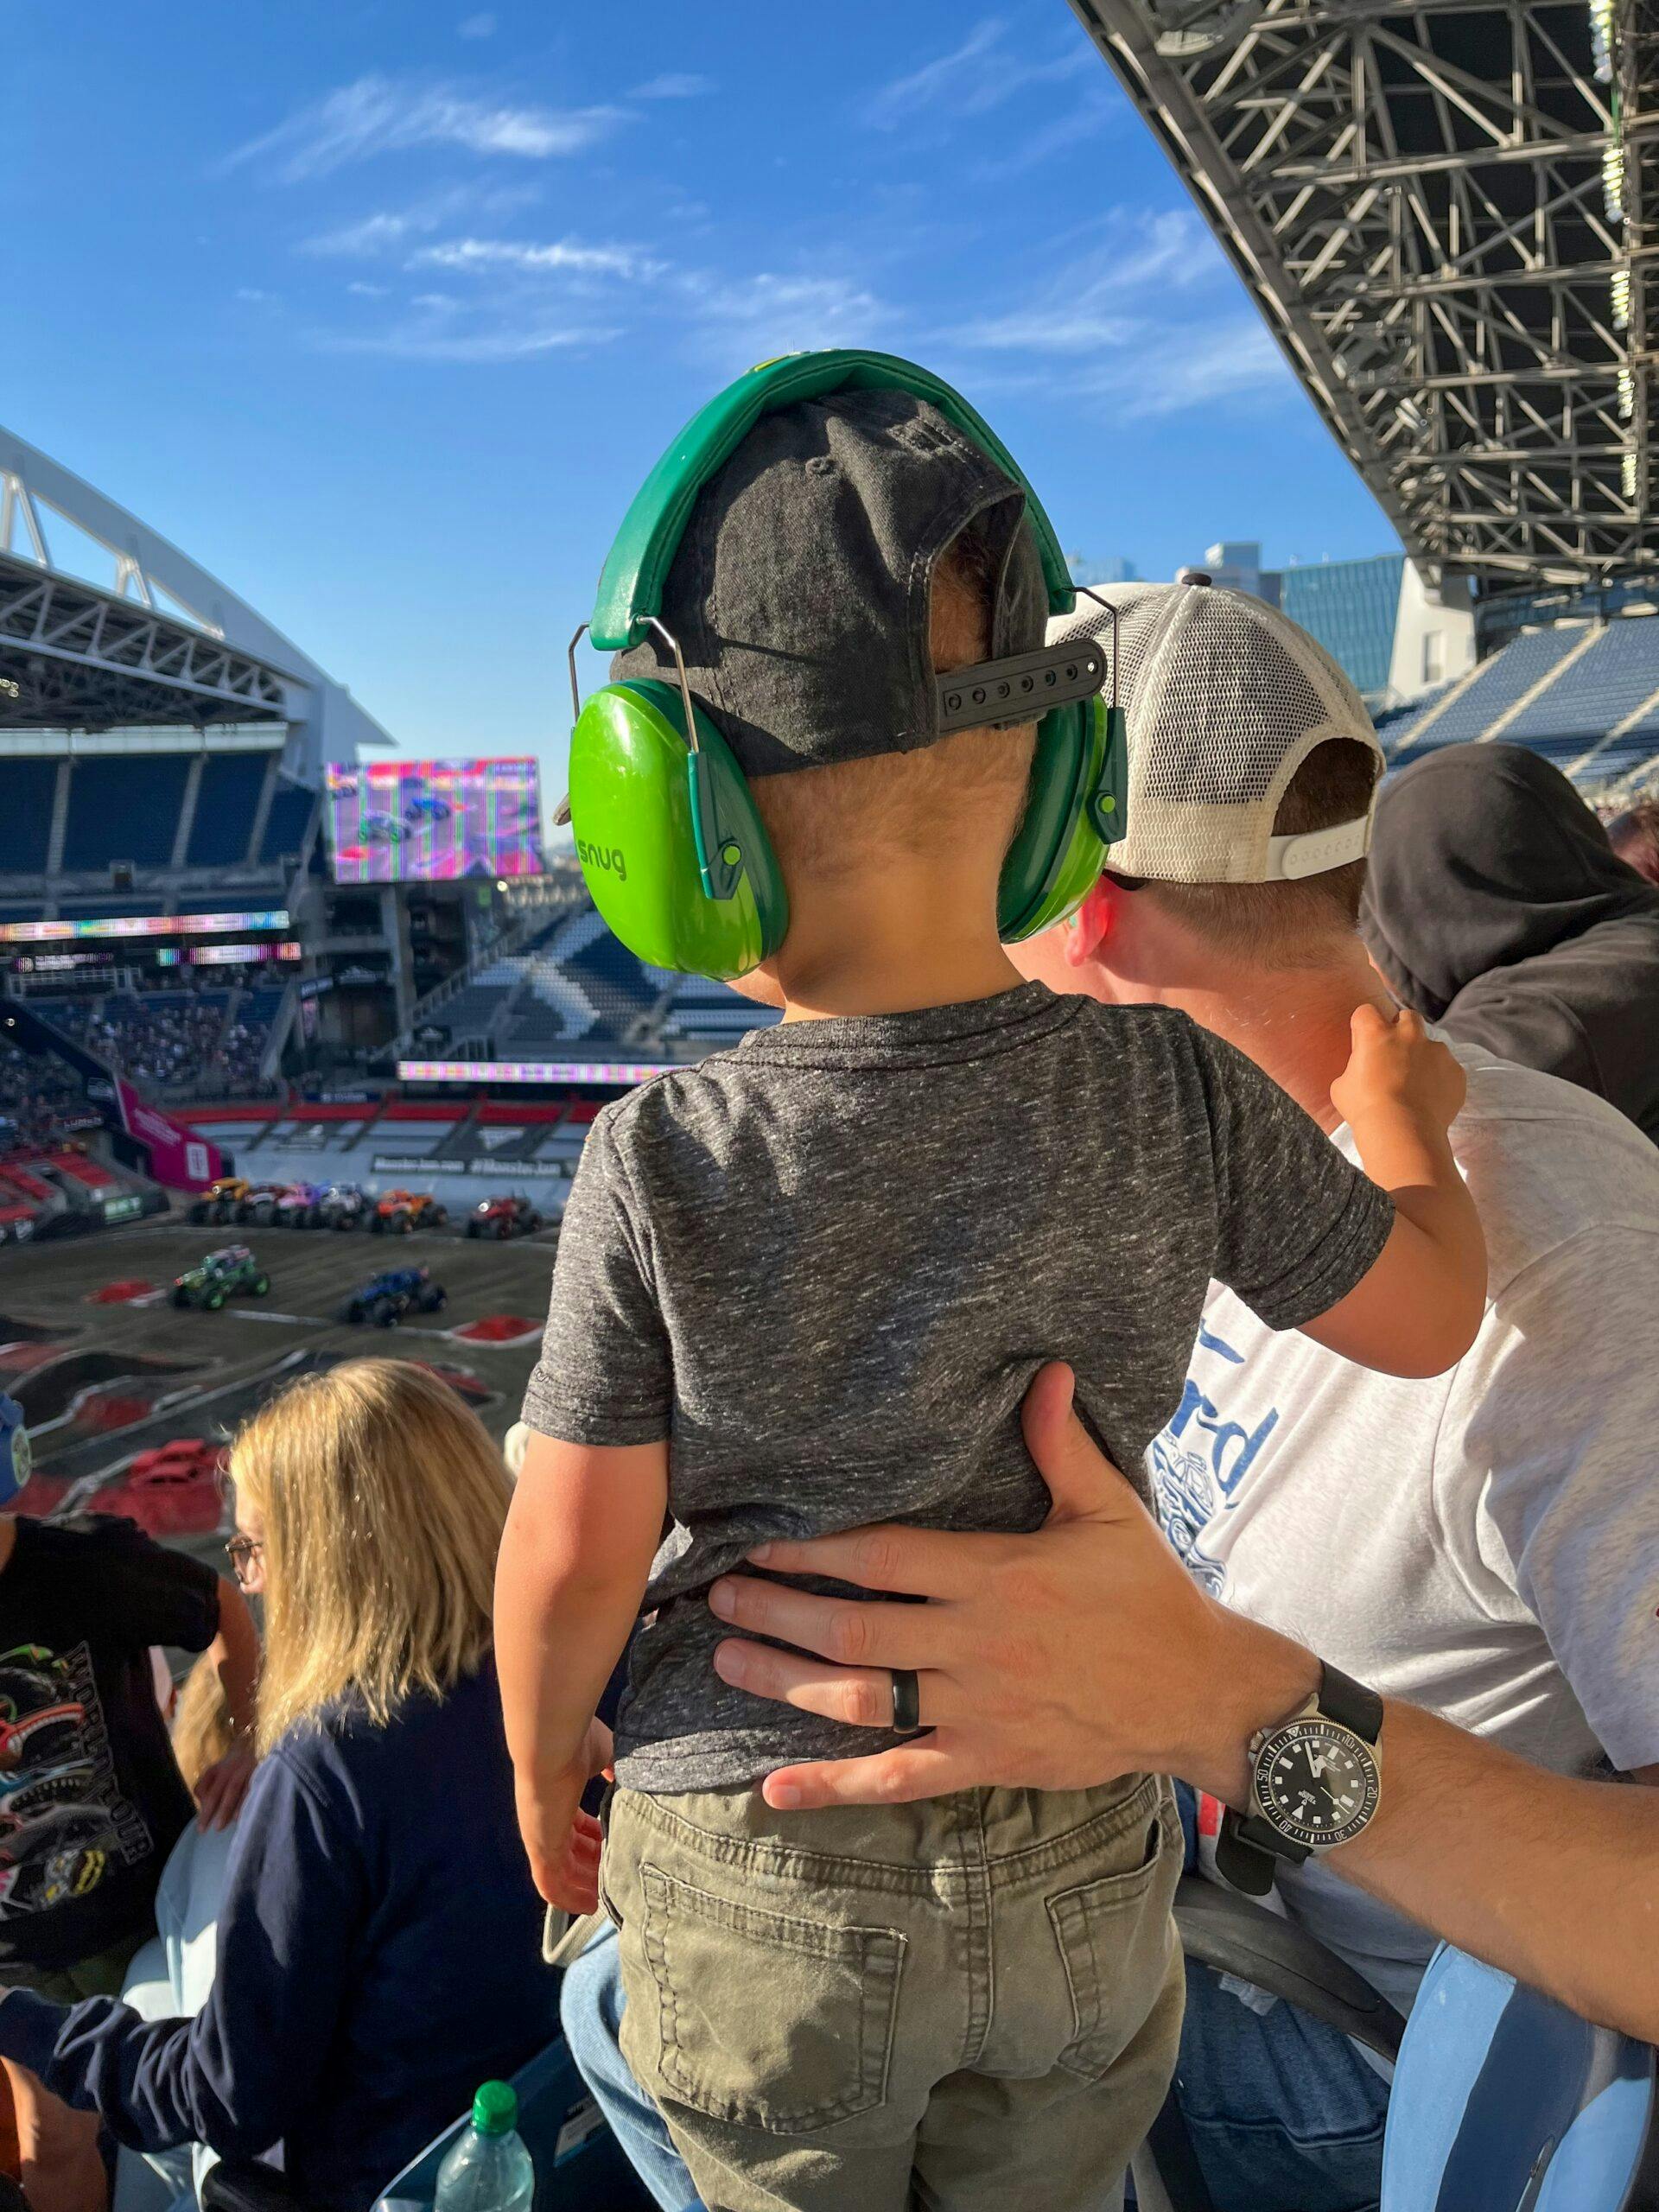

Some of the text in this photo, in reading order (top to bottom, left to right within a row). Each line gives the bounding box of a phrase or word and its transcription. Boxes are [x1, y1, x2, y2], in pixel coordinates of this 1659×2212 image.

[577, 840, 627, 881] snug
[1344, 1734, 1354, 1746] 10
[1257, 1770, 1268, 1782] 50
[1367, 1787, 1377, 1798] 20
[1279, 1820, 1293, 1833] 40
[1335, 1832, 1347, 1841] 30
